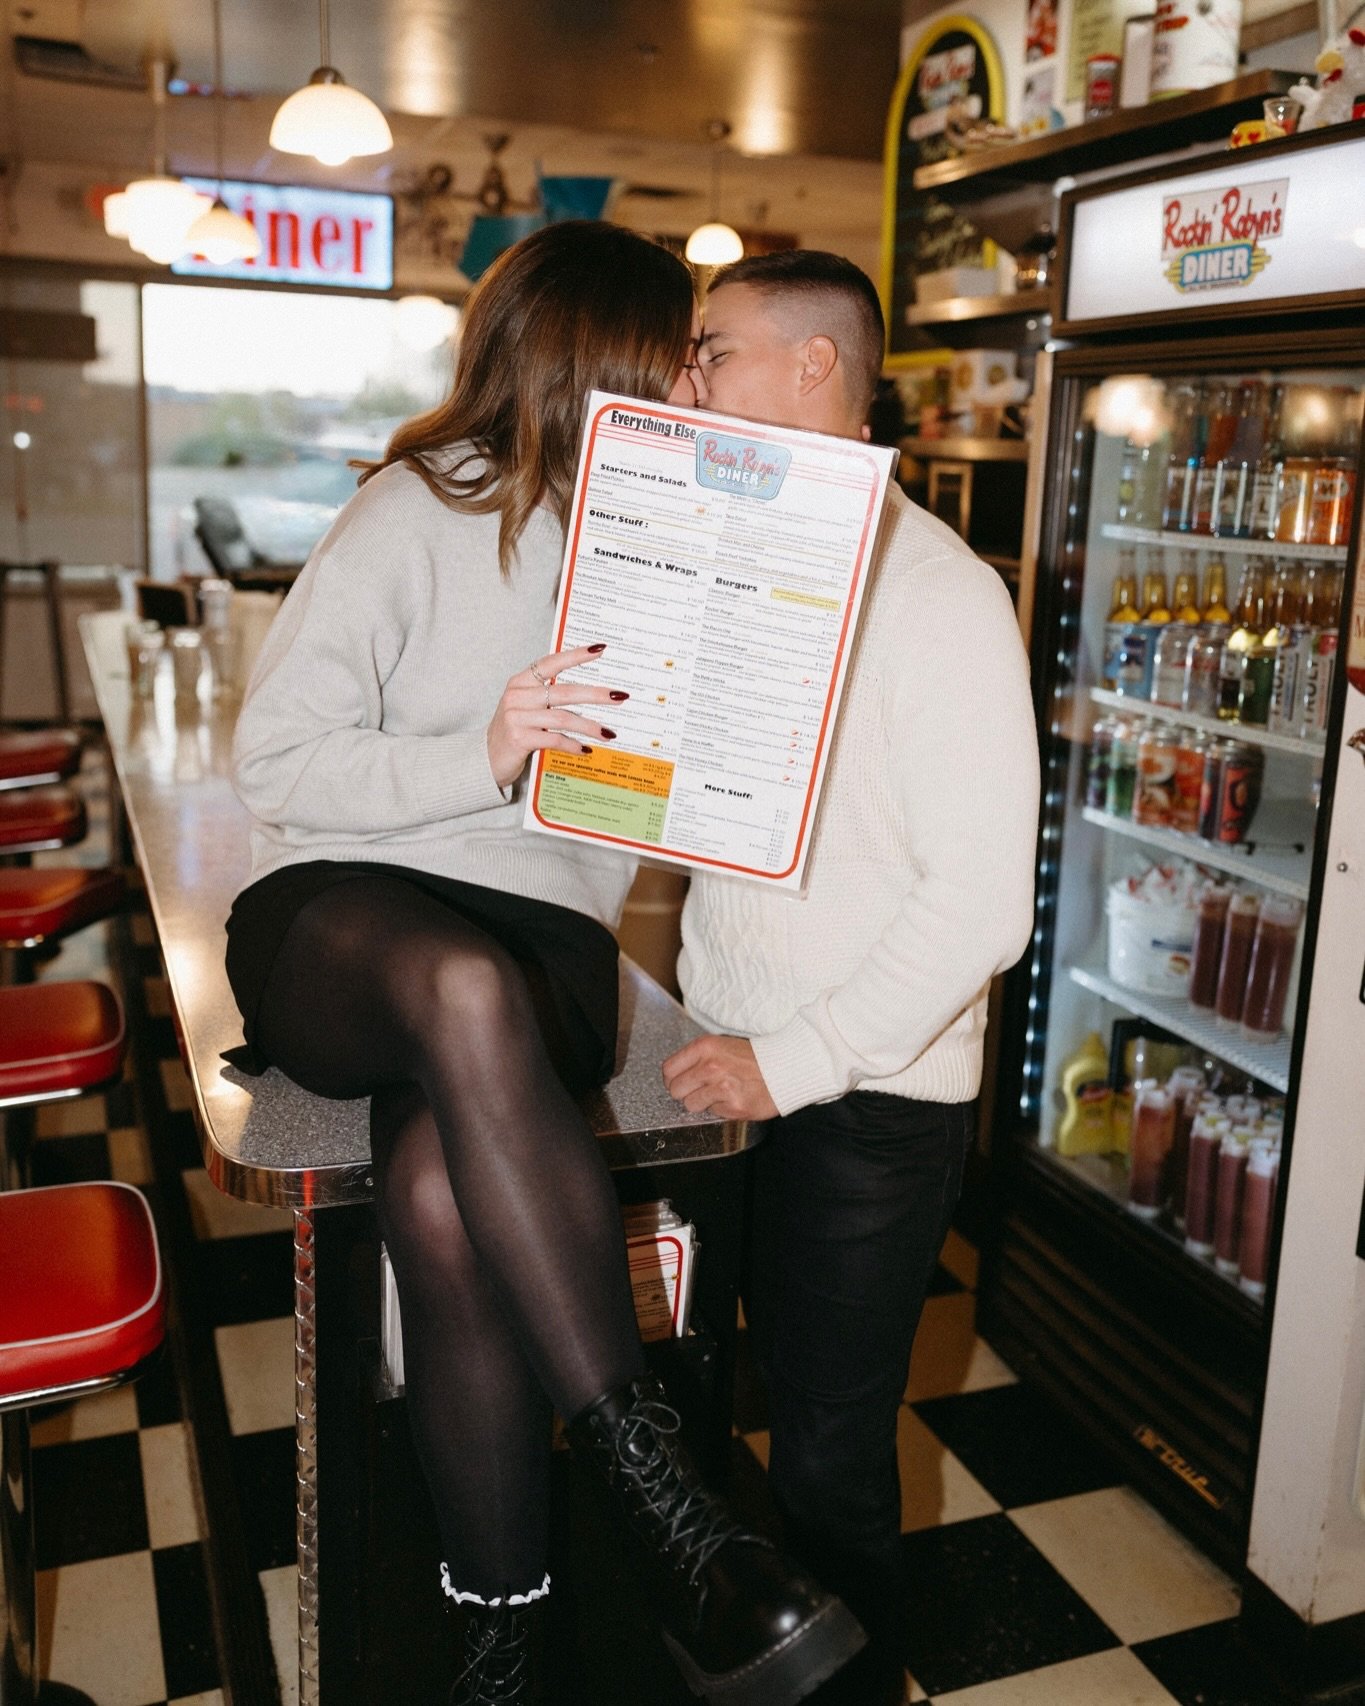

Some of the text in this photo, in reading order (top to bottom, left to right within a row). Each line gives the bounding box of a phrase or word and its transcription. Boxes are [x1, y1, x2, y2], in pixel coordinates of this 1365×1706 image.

[193, 194, 374, 272] iner
[1183, 247, 1249, 284] DINER
[610, 410, 697, 439] Everything Else
[600, 463, 637, 476] Starters
[639, 471, 656, 481] and
[657, 476, 687, 487] Salads
[717, 467, 758, 484] DINER
[588, 509, 616, 520] Other
[618, 516, 643, 526] Stuff
[593, 547, 652, 566] Sandwiches
[654, 560, 662, 568] &
[663, 562, 698, 578] Wraps
[715, 577, 758, 592] Burgers
[704, 784, 752, 799] More Stuff:
